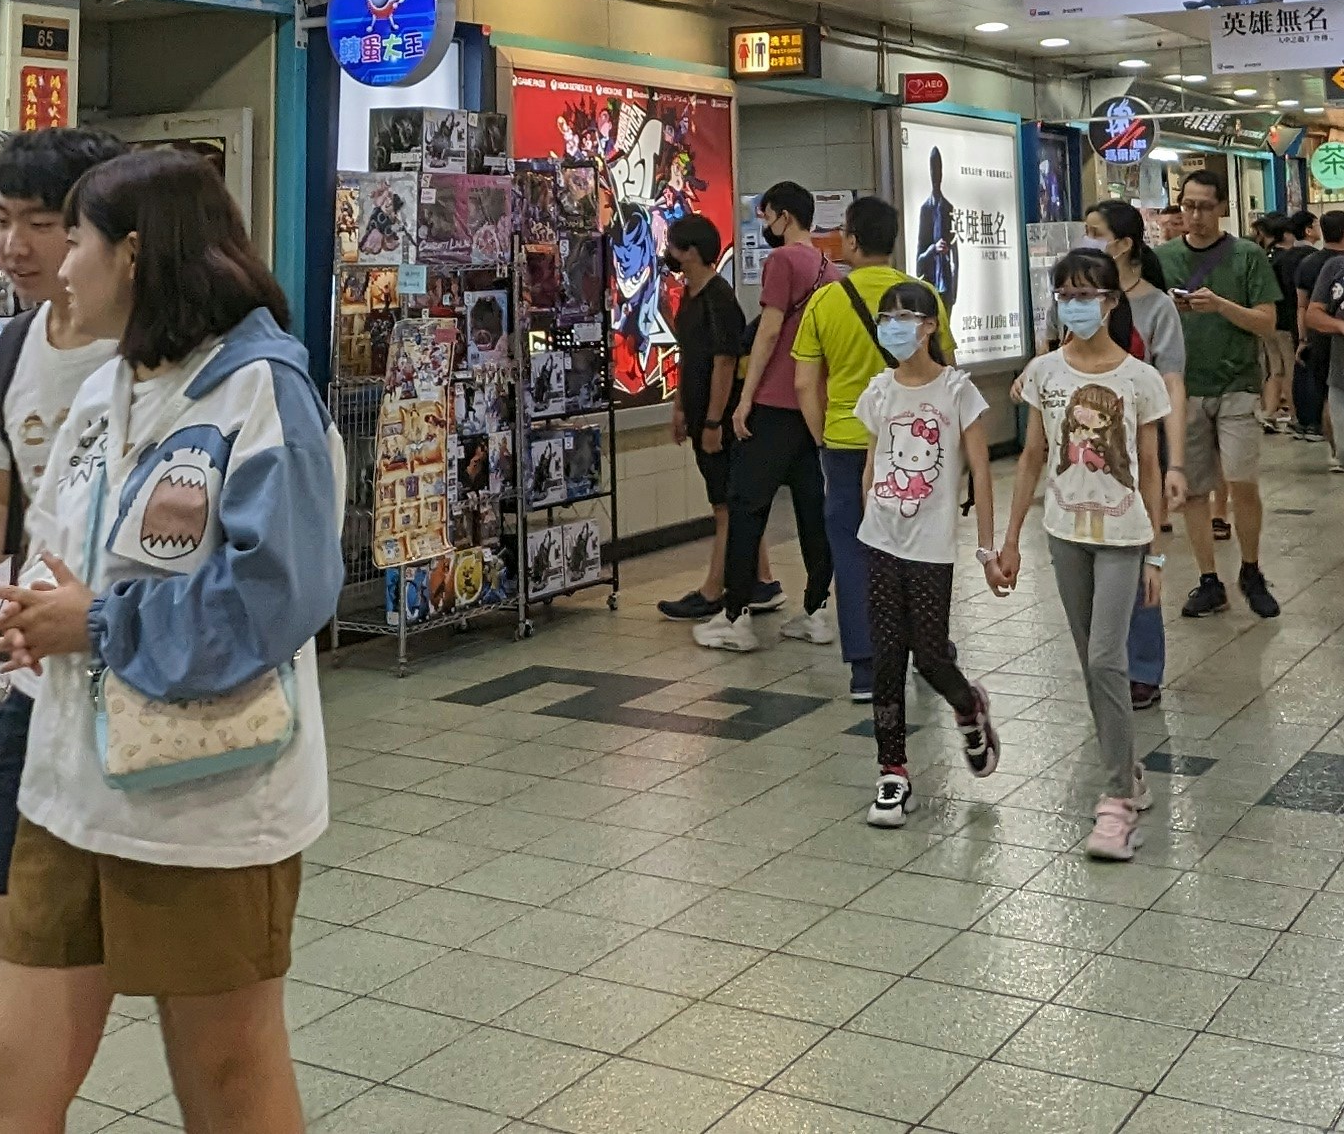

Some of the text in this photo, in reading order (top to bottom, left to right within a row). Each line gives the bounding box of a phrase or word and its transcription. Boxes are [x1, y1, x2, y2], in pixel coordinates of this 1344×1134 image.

[1221, 6, 1328, 38] 英雄無名
[38, 30, 54, 48] 65
[949, 209, 1007, 246] 英雄無名
